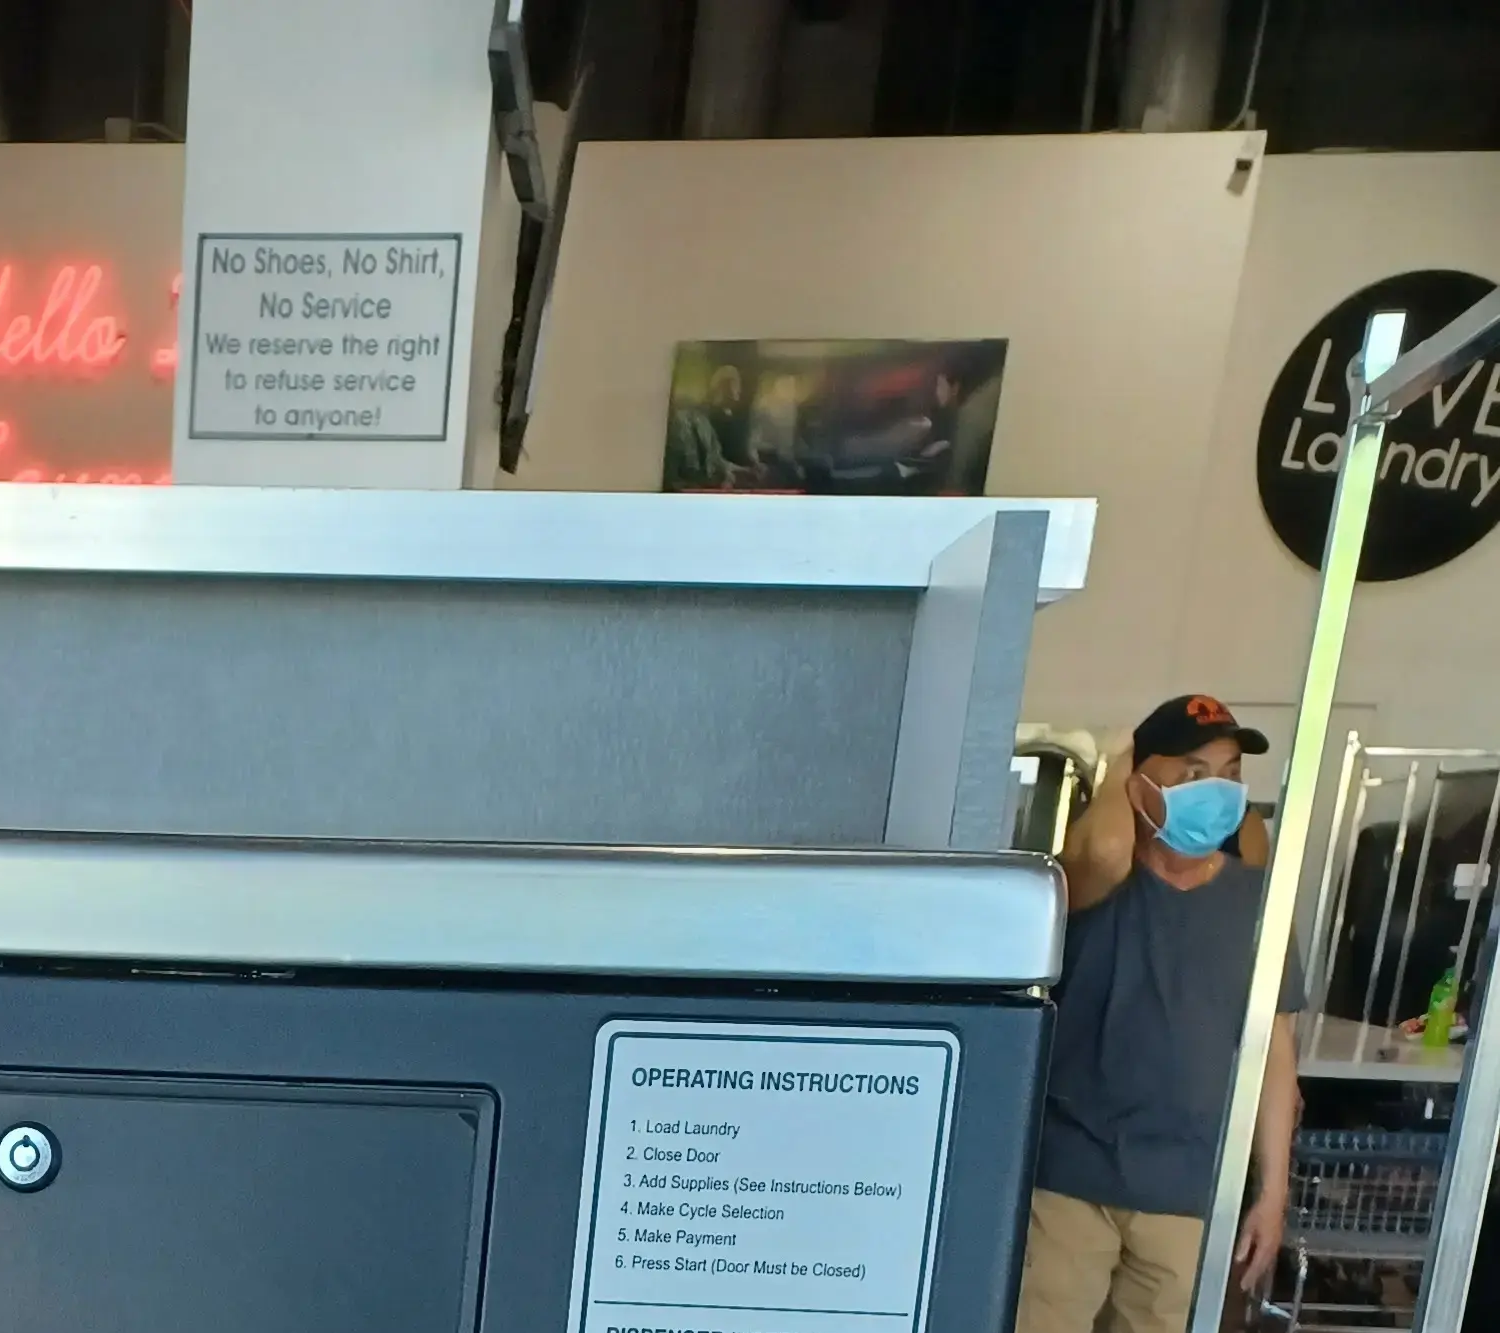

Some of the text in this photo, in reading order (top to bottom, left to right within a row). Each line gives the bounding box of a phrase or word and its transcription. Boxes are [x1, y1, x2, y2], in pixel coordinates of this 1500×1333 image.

[212, 247, 444, 279] No Shoes, No Shirt,
[260, 292, 392, 319] No Service
[206, 333, 440, 362] We reserve the right
[225, 369, 416, 392] to refuse service
[254, 404, 382, 430] to anyone!
[1281, 417, 1500, 508] Landry
[632, 1067, 919, 1095] OPERATING INSTRUCTIONS
[630, 1120, 740, 1139] 1. Load Laundry
[626, 1147, 720, 1163] 2. Close Door
[623, 1174, 902, 1199] 3. Add Supplies (See Instructions Below)
[620, 1201, 784, 1220] 4. Make Cycle Selection
[617, 1228, 736, 1248] 5. Make Payment
[615, 1255, 866, 1280] 6. Press Start (Door Must be Closed)
